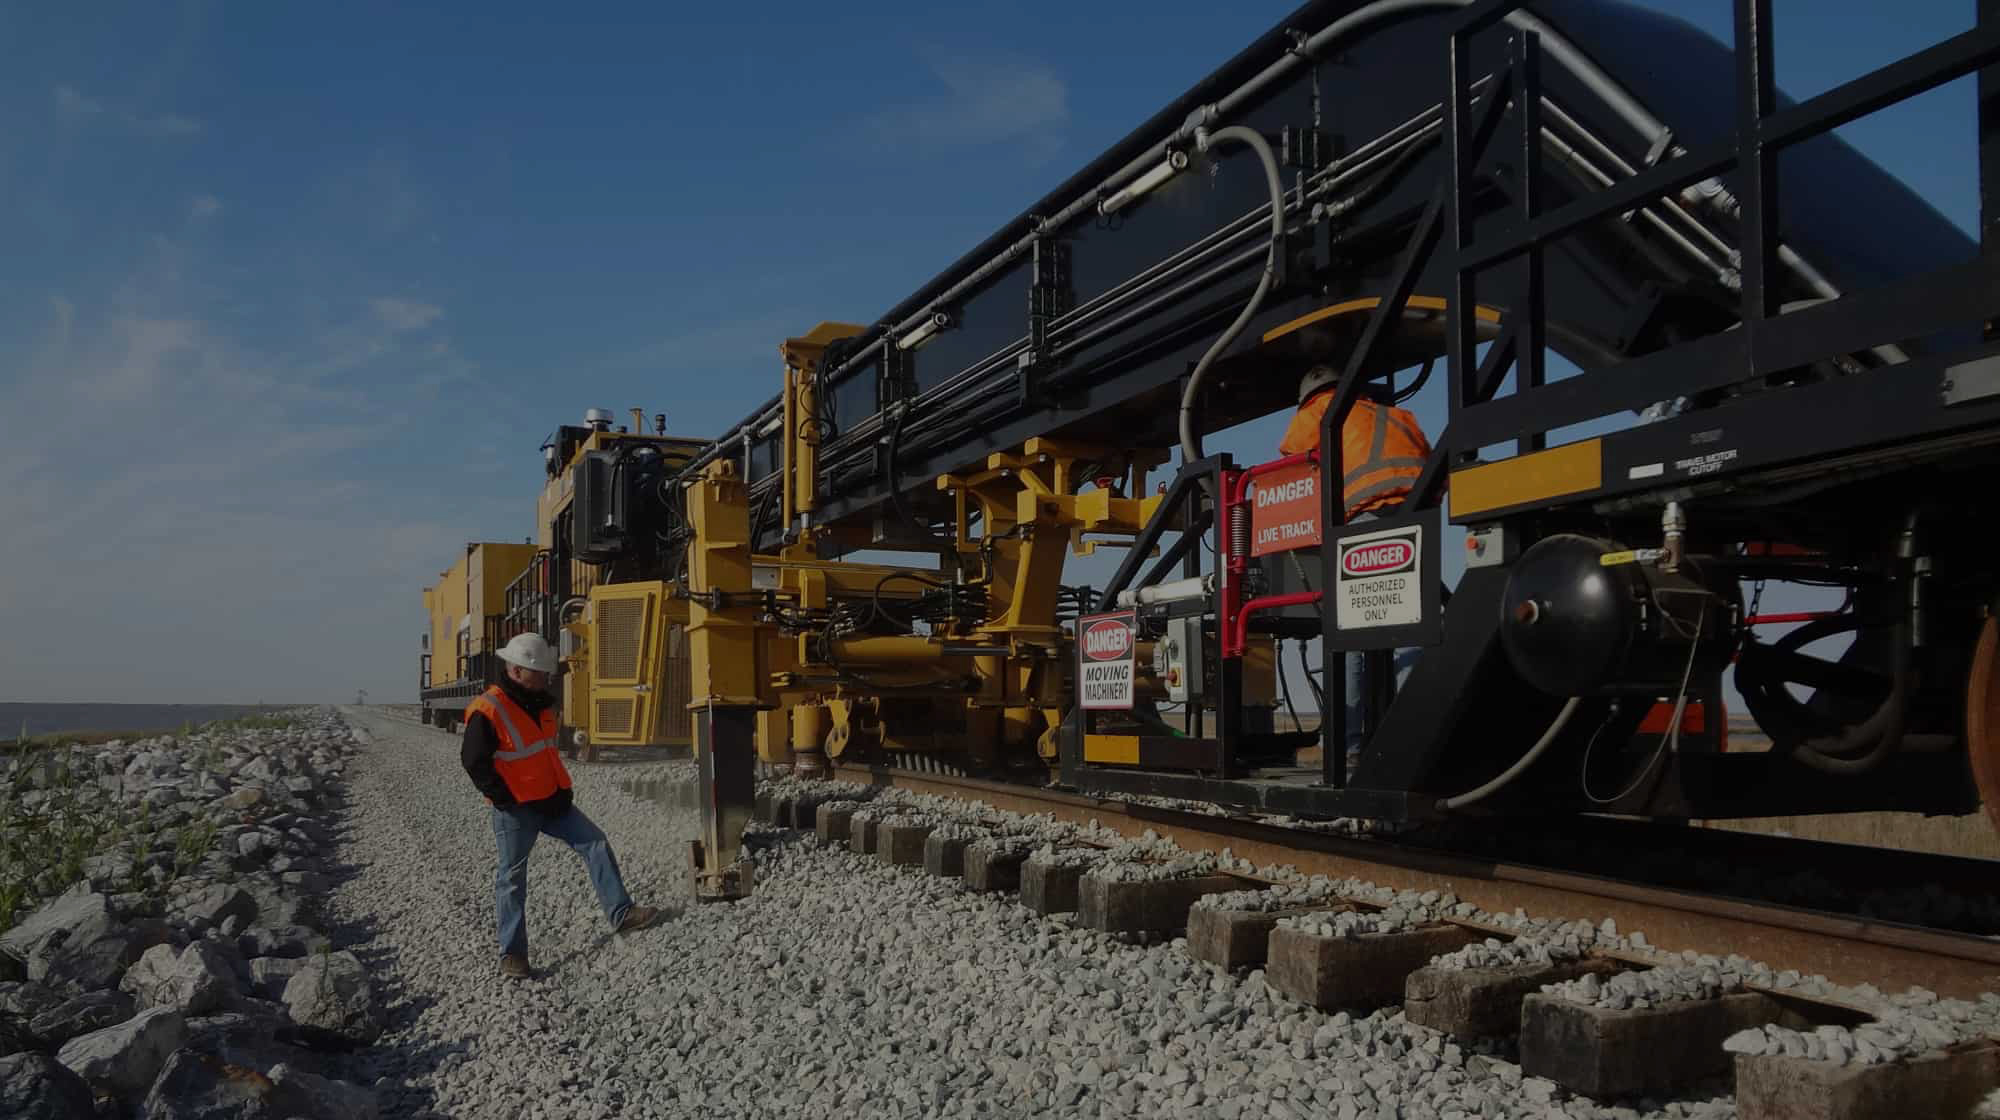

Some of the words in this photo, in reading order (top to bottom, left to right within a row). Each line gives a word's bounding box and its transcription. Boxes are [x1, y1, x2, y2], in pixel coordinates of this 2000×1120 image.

[1705, 449, 1737, 463] MOTOR
[1687, 460, 1723, 476] CUTOFF
[1258, 477, 1314, 508] DANGER
[1258, 527, 1279, 544] LIVE
[1280, 519, 1315, 539] TRACK
[1350, 545, 1404, 569] DANGER
[1349, 578, 1406, 595] AUTHORIZED
[1351, 593, 1404, 608] PERSONNEL
[1364, 608, 1388, 621] ONLY
[1087, 628, 1128, 652] DANGER
[1086, 665, 1129, 681] MOVING
[1085, 682, 1129, 700] MACHINERY
